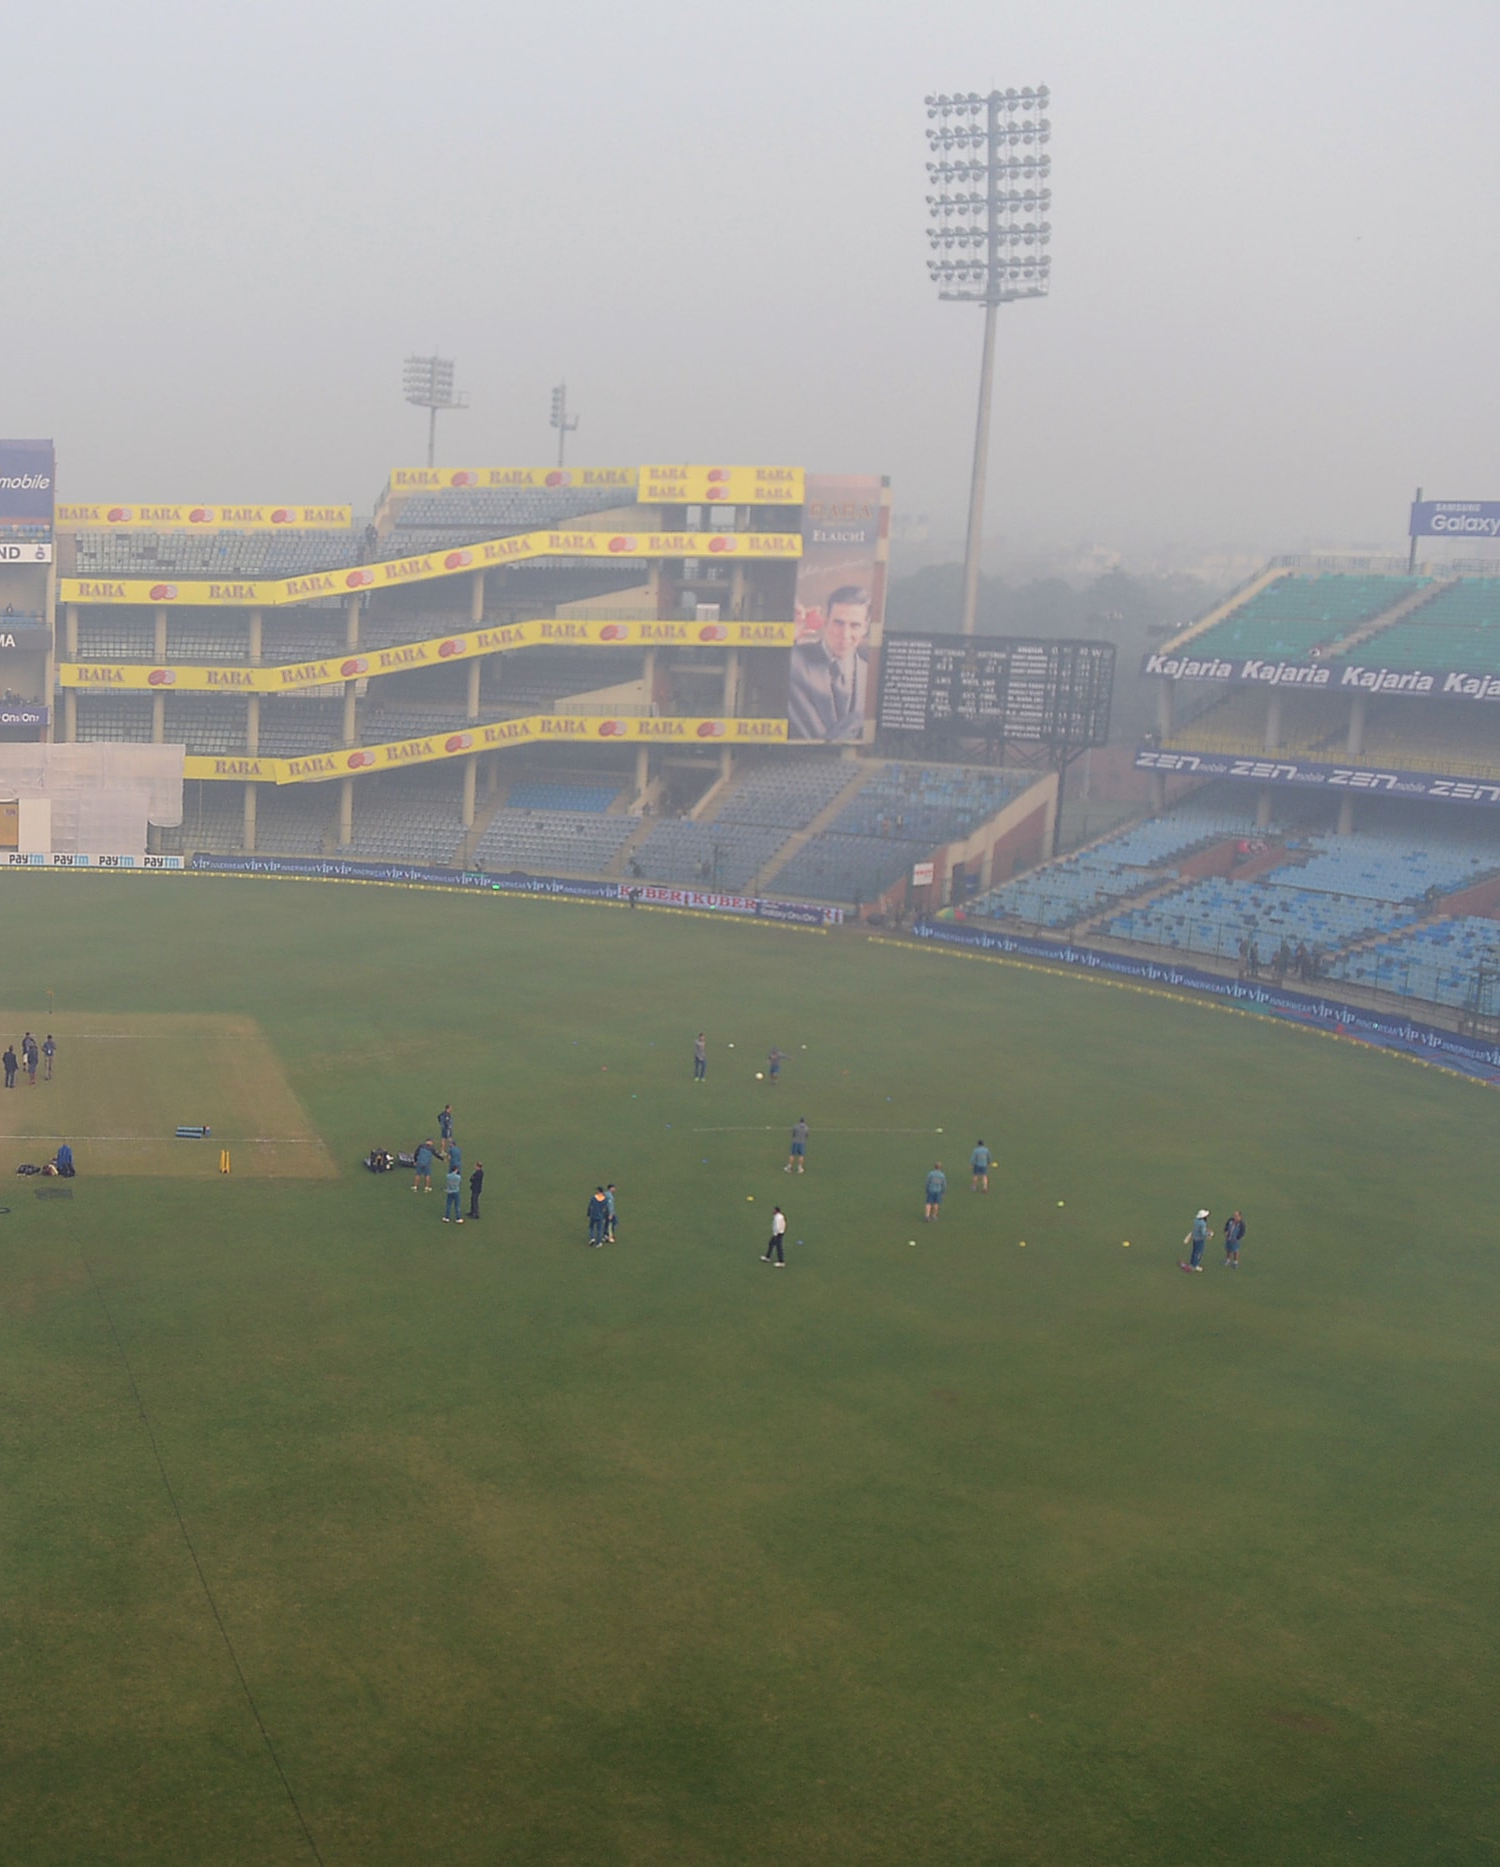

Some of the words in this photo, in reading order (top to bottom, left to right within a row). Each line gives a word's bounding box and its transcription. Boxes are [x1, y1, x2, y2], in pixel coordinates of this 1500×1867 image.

[1431, 514, 1500, 535] Galaxy
[1146, 655, 1232, 679] Kajaria
[1241, 660, 1330, 685] Kajaria
[1342, 666, 1434, 692] Kajaria
[9, 853, 44, 865] paytm
[54, 854, 88, 865] paytm
[99, 855, 134, 867] paytm
[144, 856, 179, 868] paytm
[620, 884, 681, 901] KBER
